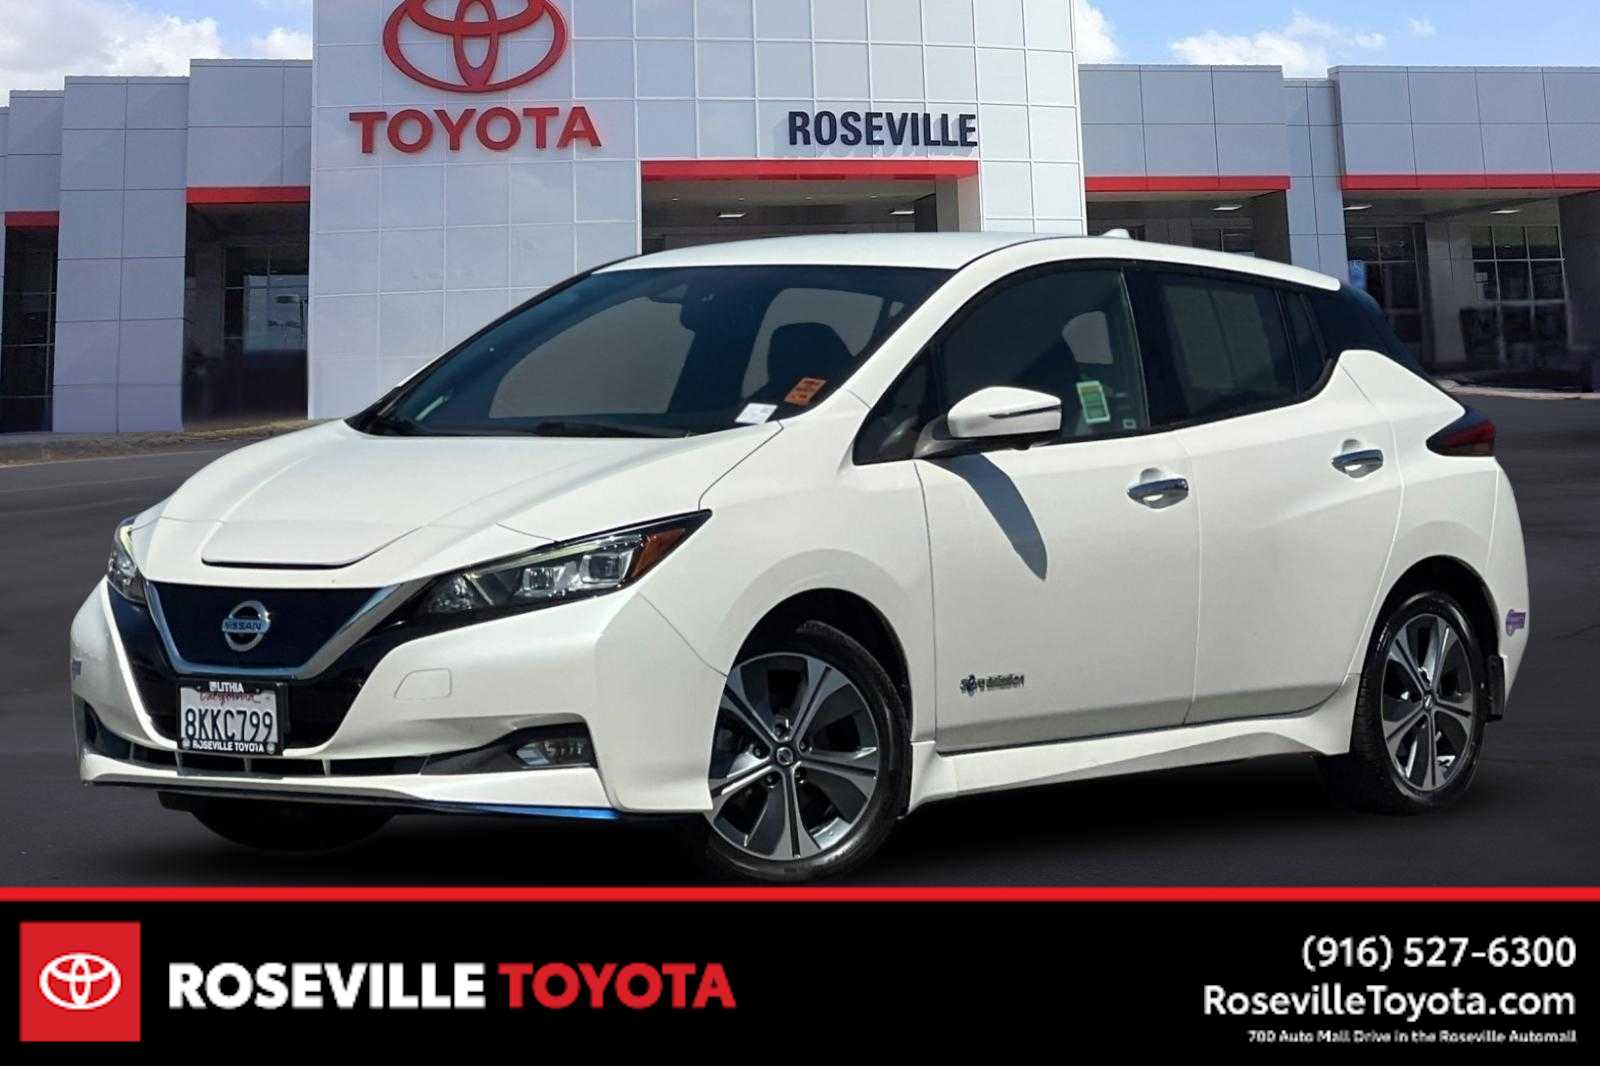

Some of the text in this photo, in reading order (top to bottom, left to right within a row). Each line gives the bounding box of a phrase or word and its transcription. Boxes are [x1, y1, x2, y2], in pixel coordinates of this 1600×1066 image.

[349, 106, 602, 154] TOYOTA
[788, 110, 978, 147] ROSEVILLE
[217, 681, 244, 693] LITHIA
[185, 708, 273, 742] 8KKC799
[192, 741, 264, 753] ROSEVILLE TOYOTA
